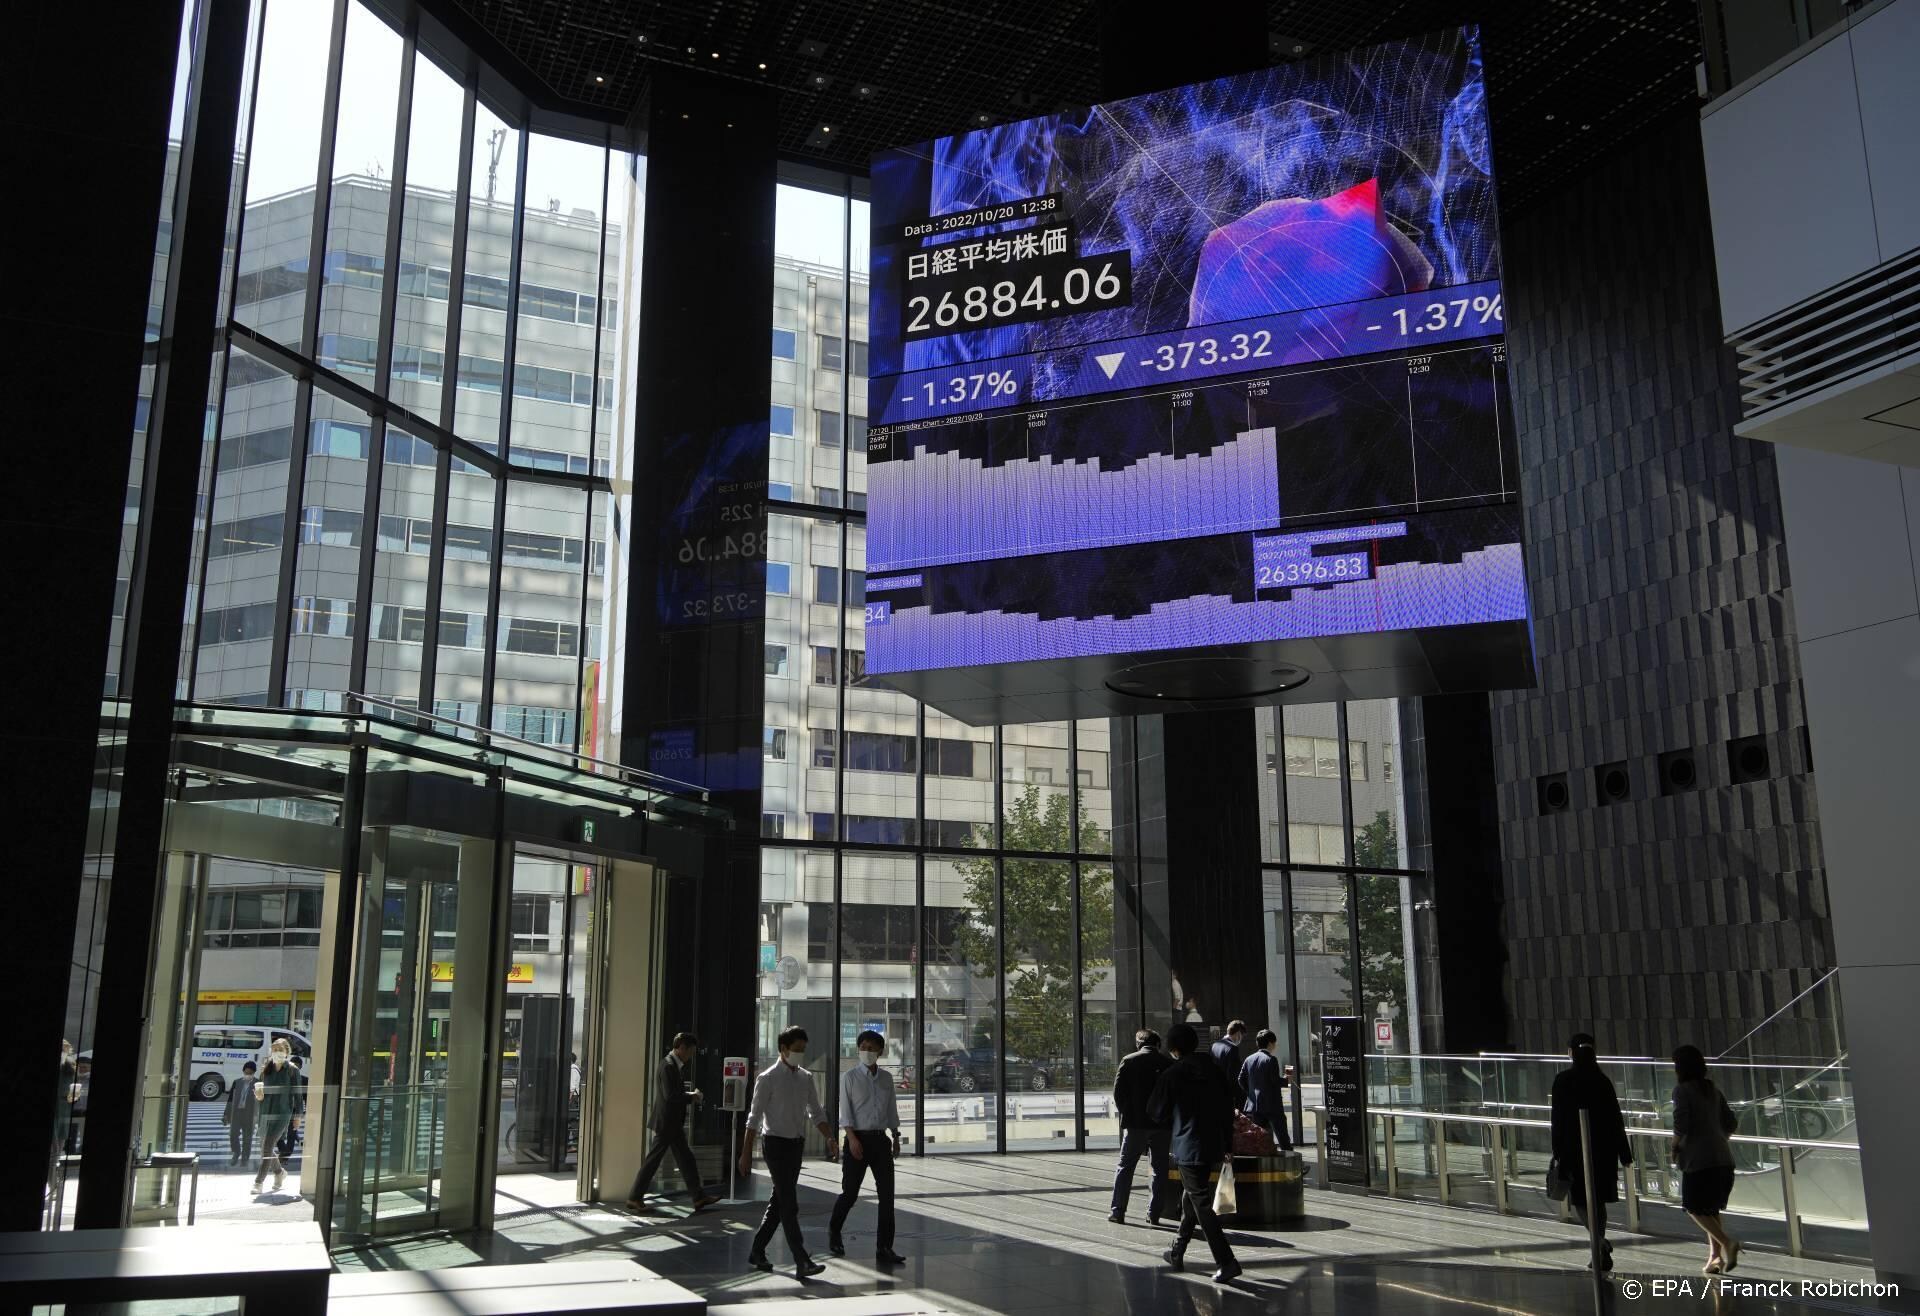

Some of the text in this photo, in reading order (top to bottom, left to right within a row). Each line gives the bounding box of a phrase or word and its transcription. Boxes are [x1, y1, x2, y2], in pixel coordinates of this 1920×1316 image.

[943, 206, 1014, 229] 2022/10/20
[1021, 198, 1056, 214] 12:38
[908, 227, 1068, 281] 日経平均株価
[907, 262, 1121, 333] 26884.06
[1139, 330, 1273, 373] -373.32
[1407, 357, 1431, 366] 27317
[1408, 365, 1430, 374] 12:30
[1248, 380, 1270, 389] 26954
[1171, 391, 1194, 400] 26906
[1248, 388, 1268, 397] 11:30
[1172, 399, 1192, 408] 11:00
[1027, 411, 1048, 421] 26947
[923, 418, 940, 428] Chart
[1028, 420, 1046, 428] 10:00
[1259, 557, 1362, 585] 26396.83
